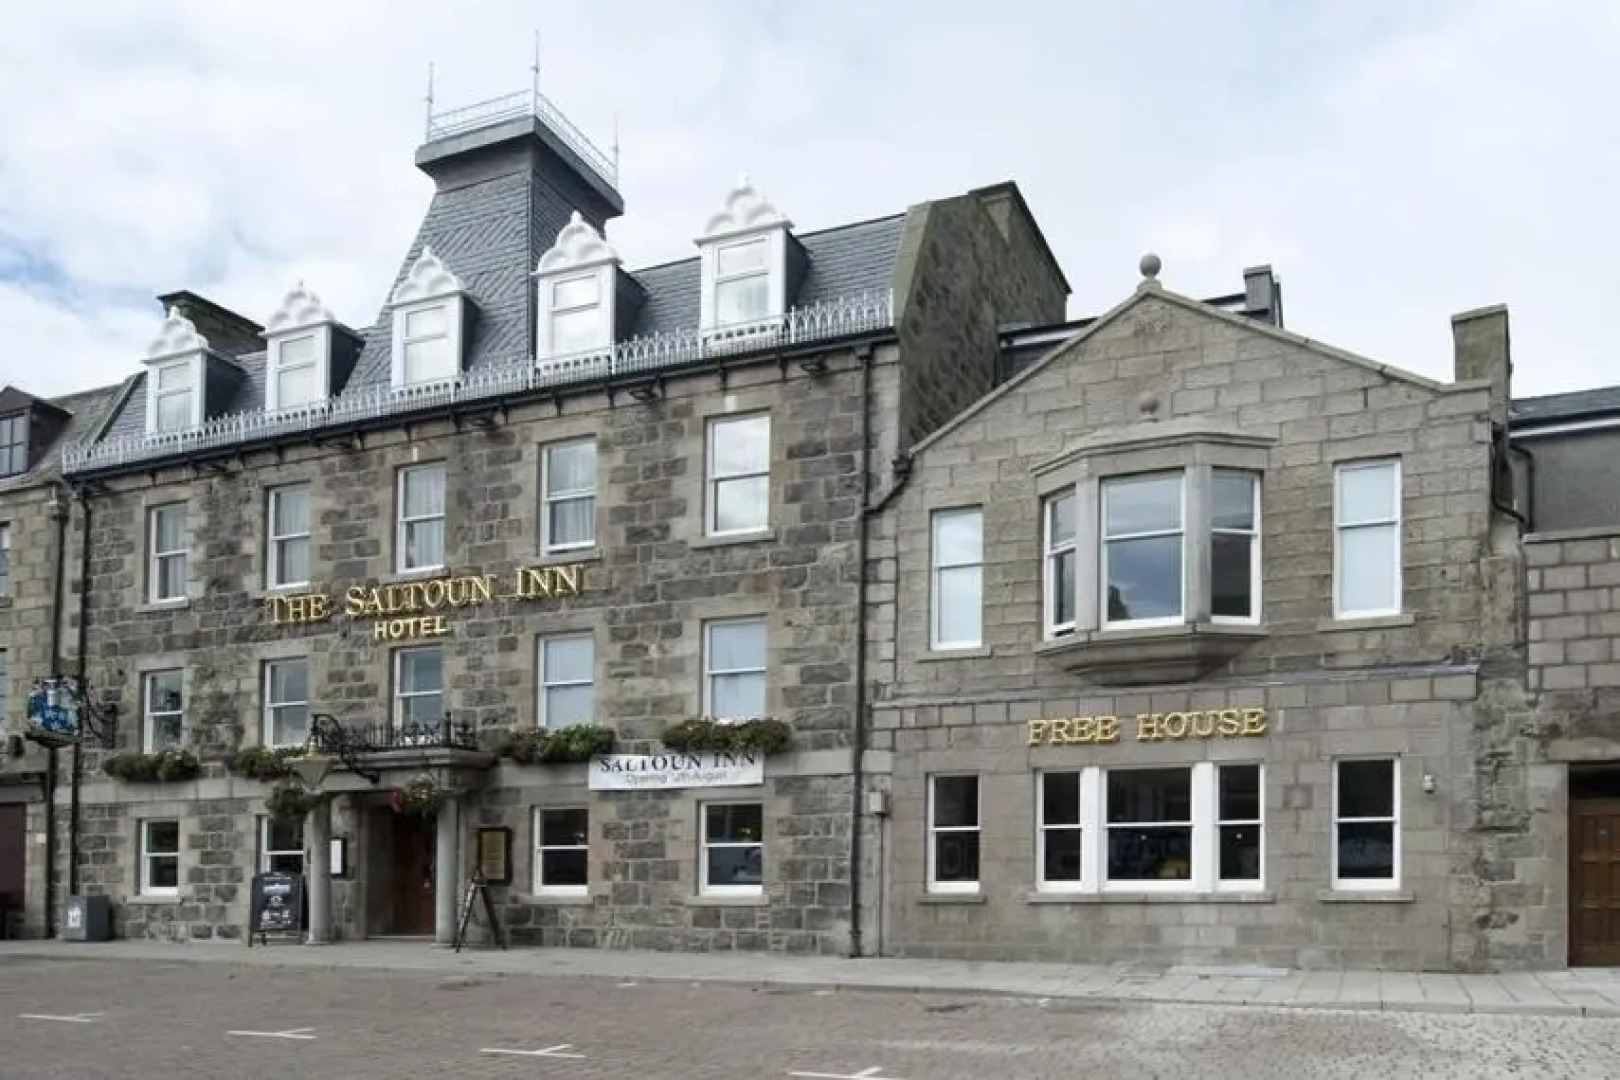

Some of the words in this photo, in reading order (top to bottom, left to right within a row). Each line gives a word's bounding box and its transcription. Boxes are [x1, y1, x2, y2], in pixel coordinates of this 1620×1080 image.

[265, 594, 329, 623] THE
[346, 574, 496, 615] SALTOUN
[515, 564, 583, 597] INN
[374, 615, 447, 639] HOTEL
[1028, 716, 1120, 745] FREE
[1136, 708, 1267, 739] HOUSE
[713, 751, 755, 768] INN
